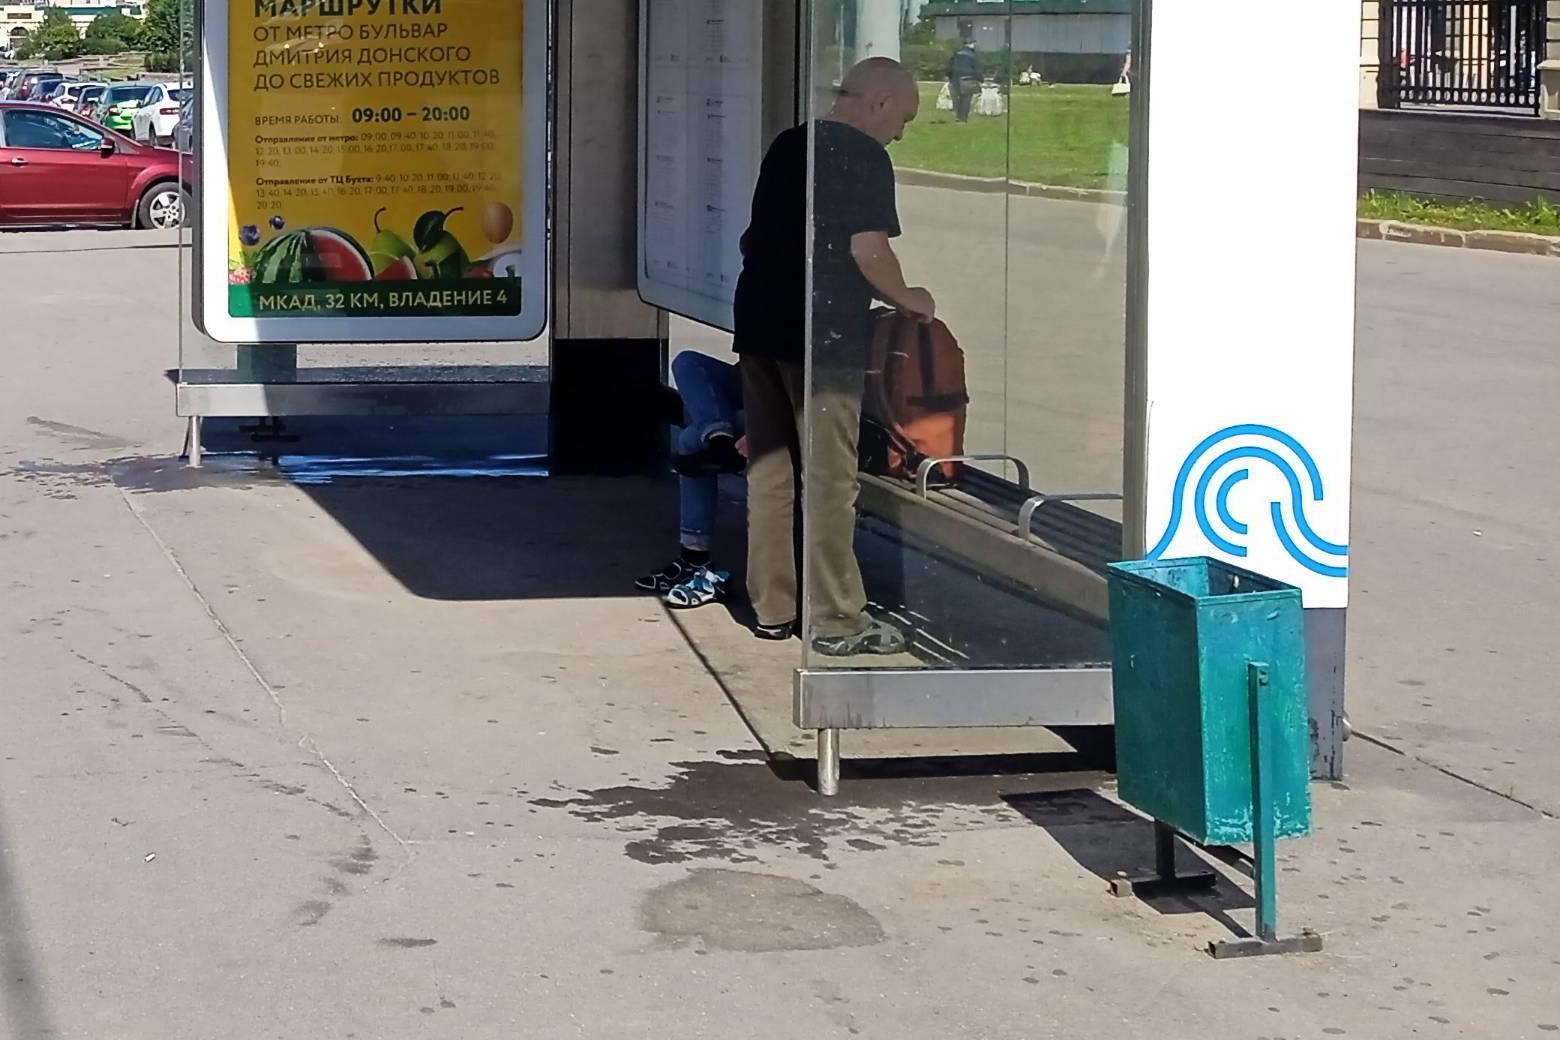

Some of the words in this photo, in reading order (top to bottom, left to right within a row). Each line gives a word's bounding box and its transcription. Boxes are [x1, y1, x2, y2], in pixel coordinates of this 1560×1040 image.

[253, 26, 281, 41] ОТ
[286, 24, 354, 41] МЕТРО
[359, 22, 448, 40] БУЛЬВАР
[253, 48, 352, 68] ДМИТРИЯ
[357, 45, 471, 65] ДОНСКОГО
[254, 73, 284, 92] ДО
[290, 71, 372, 89] СВЕЖИХ
[378, 69, 500, 88] ПРОДУКТОВ
[255, 115, 291, 126] ВРЕМЯ
[352, 107, 402, 123] 09:00
[422, 106, 470, 121] 20:00
[256, 177, 316, 186] Отправление
[331, 175, 344, 185] ТЦ
[259, 295, 321, 311] МКАД,
[325, 294, 345, 308] 32
[349, 292, 384, 309] КМ,
[389, 290, 492, 308] ВЛАДЕНИЕ
[496, 289, 507, 304] 4
